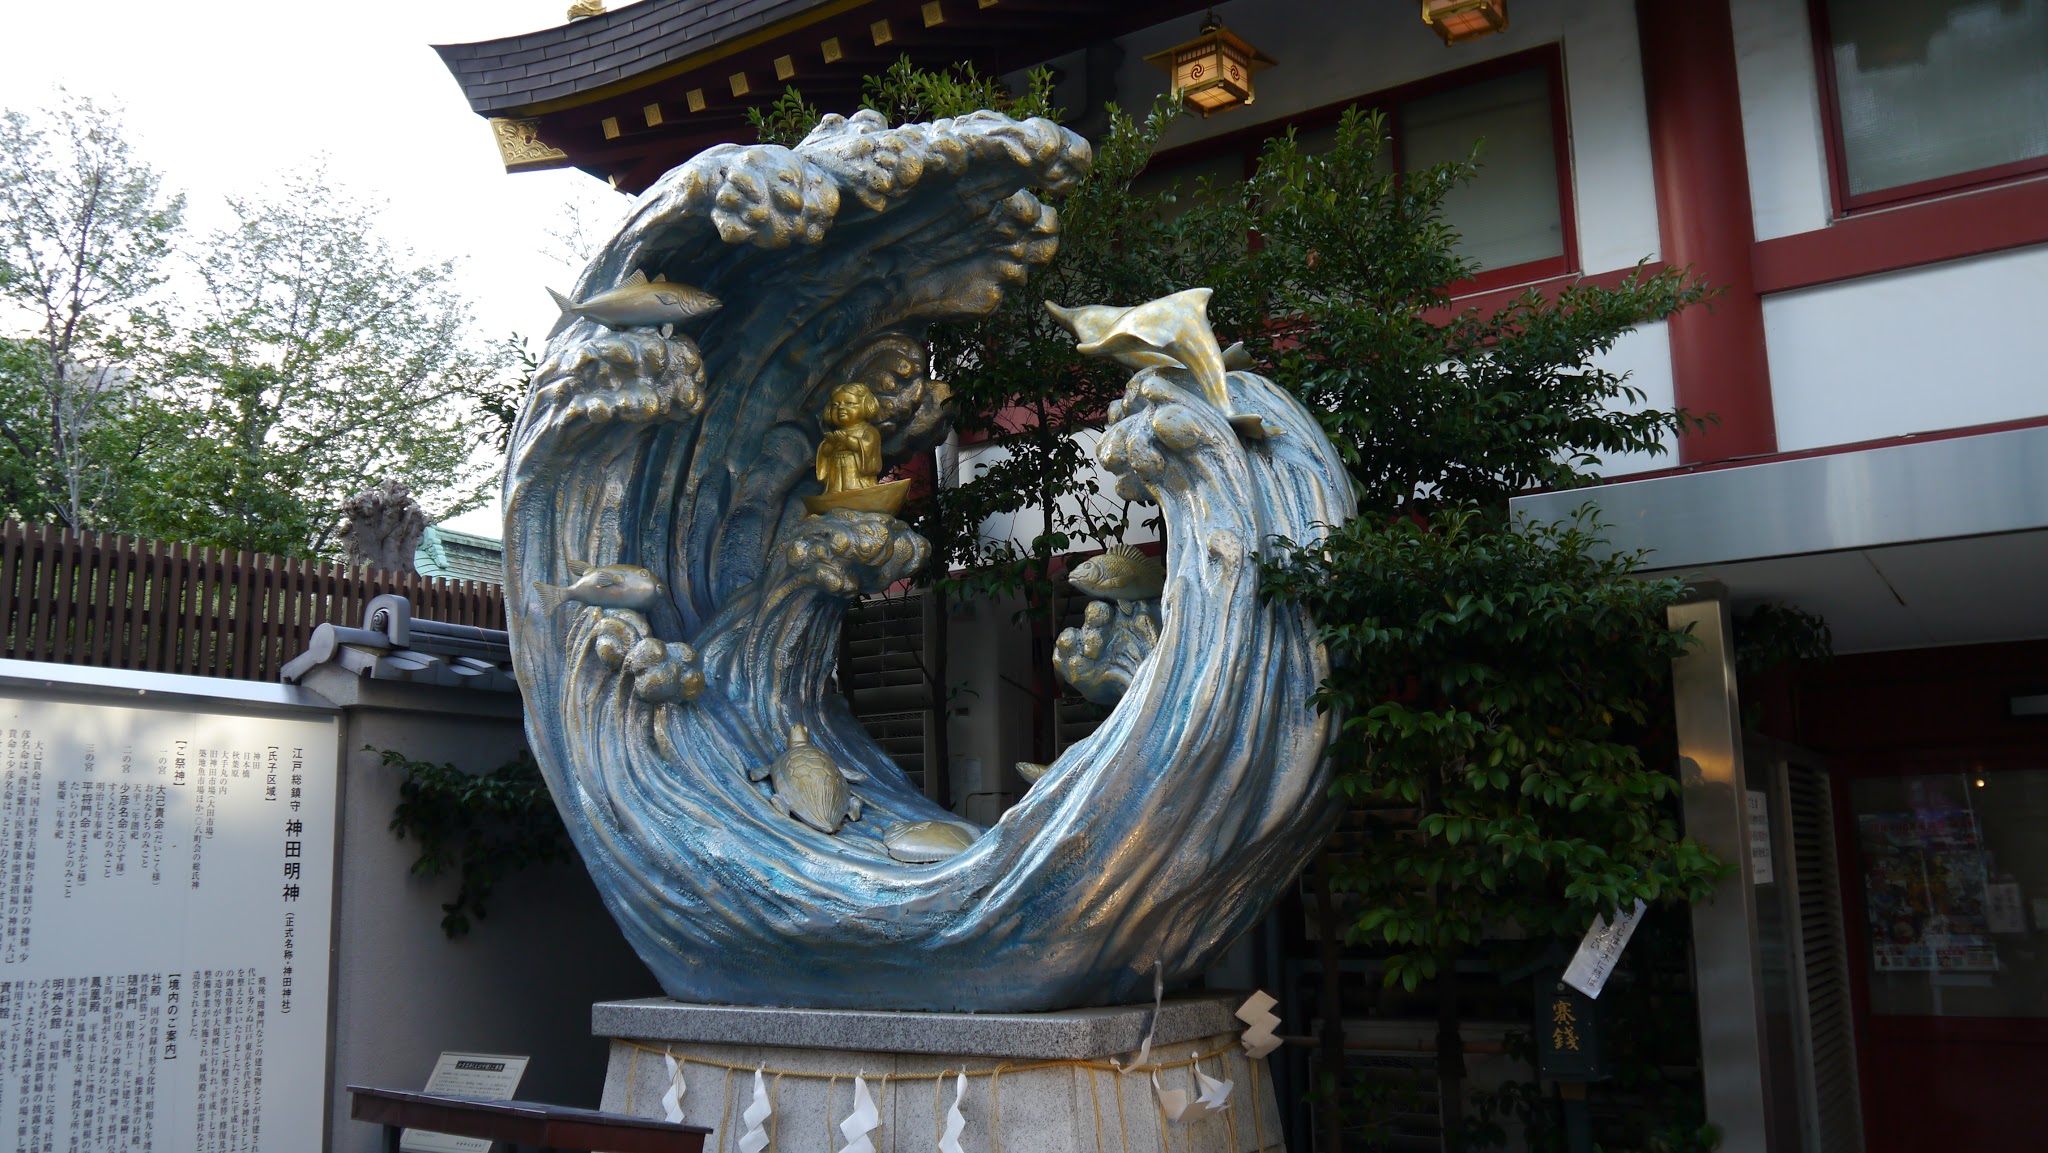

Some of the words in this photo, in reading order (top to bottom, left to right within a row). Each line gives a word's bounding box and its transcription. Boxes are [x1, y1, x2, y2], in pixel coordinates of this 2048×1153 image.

[84, 743, 95, 772] 三の宮
[121, 745, 132, 774] 二の宮
[158, 749, 168, 775] 一の宮
[173, 740, 188, 786] 【ご祭神】
[218, 750, 229, 795] 大手丸の内
[231, 750, 240, 778] 秋葉原
[242, 751, 251, 778] 日本橋
[252, 752, 261, 770] 神田
[265, 746, 279, 801] 【氏子区域】
[290, 747, 303, 812] 江戸総鎮守
[64, 781, 80, 899] たいらのまさかどのみこと
[103, 782, 117, 878] すくなひこなのみこと
[141, 784, 154, 869] おおなむちのみこと
[282, 818, 303, 902] 神田明神
[150, 972, 162, 996] 社殿
[281, 912, 295, 1014] （正式名称・神田神社）
[49, 978, 65, 1029] 明神会館
[89, 976, 102, 1012] 鳳凰殿
[163, 973, 181, 1060] 【境内のご案内】
[189, 970, 200, 1040] 造営されました。
[206, 970, 223, 1153] の造営等が大規模に行われ、平成十七年に
